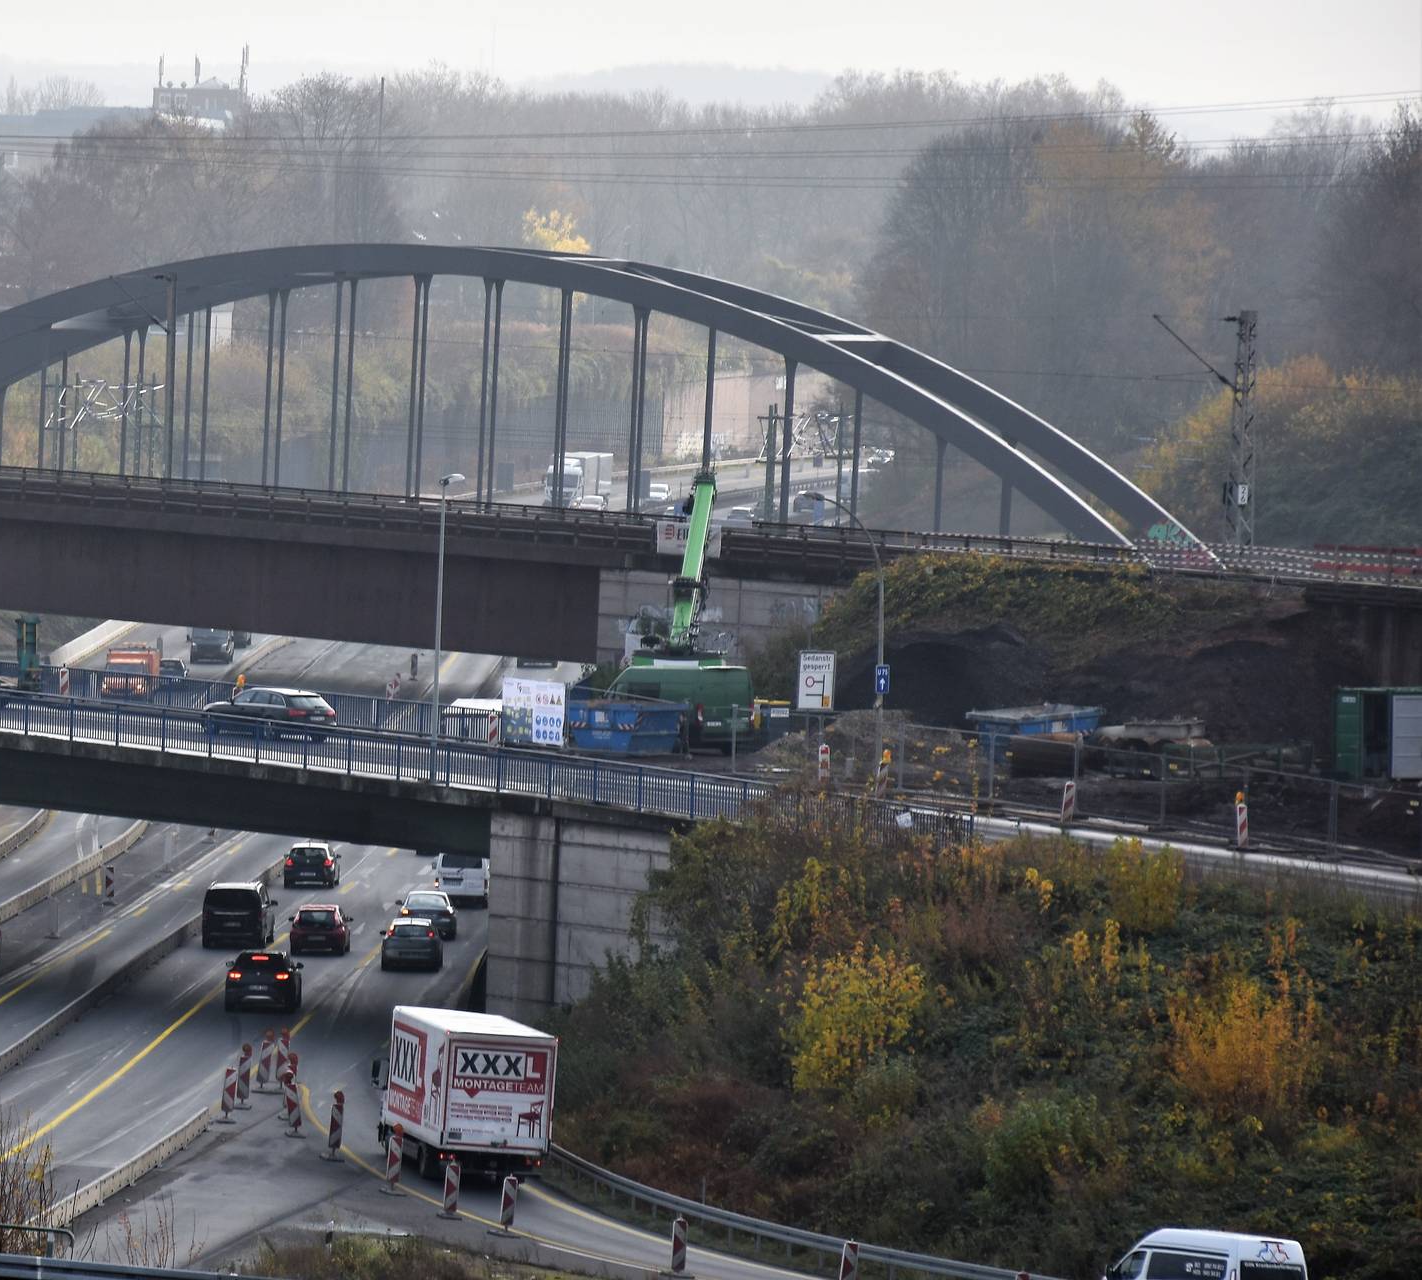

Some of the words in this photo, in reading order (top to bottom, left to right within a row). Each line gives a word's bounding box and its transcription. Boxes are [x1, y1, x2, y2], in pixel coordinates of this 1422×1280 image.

[802, 663, 831, 671] gesperrt
[877, 668, 882, 676] U
[393, 1035, 422, 1089] XXXL
[459, 1052, 541, 1079] XXXL
[454, 1078, 544, 1094] MONTAGETEAM
